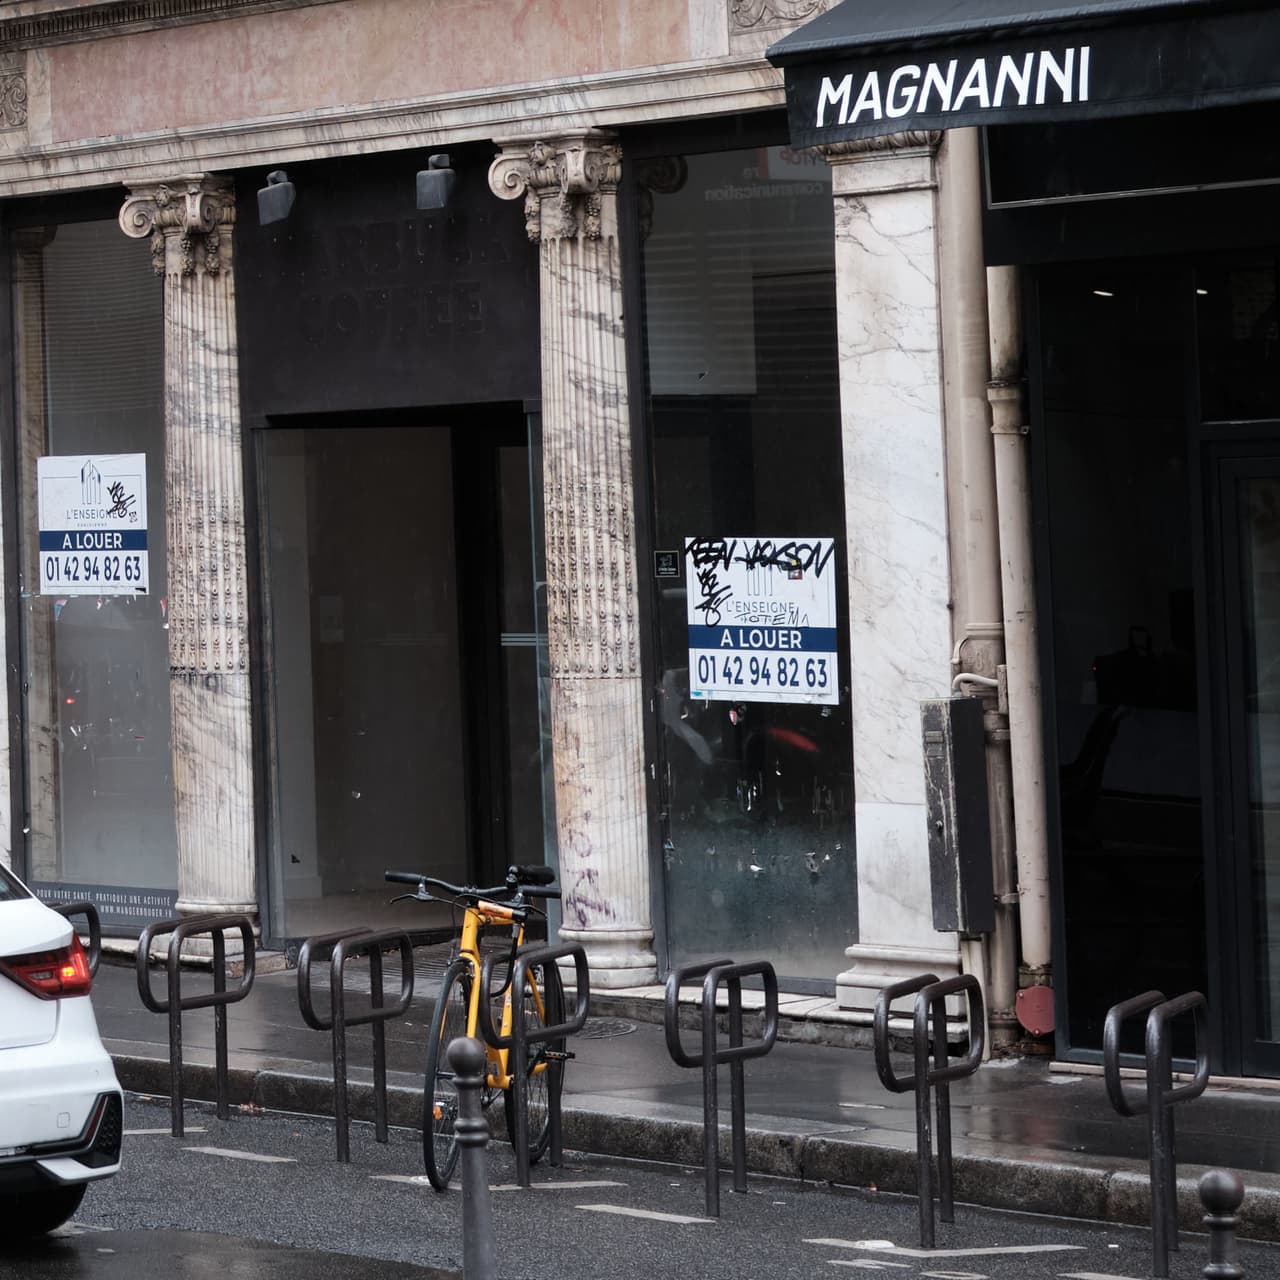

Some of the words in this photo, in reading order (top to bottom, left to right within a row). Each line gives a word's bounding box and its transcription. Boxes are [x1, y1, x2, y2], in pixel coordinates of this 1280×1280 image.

[816, 46, 1091, 128] MAGNANNI
[62, 533, 73, 550] A
[76, 532, 122, 549] LOUER
[46, 556, 60, 582] 01
[64, 556, 80, 581] 42
[83, 556, 100, 581] 94
[104, 556, 121, 581] 82
[124, 556, 141, 581] 63
[726, 602, 795, 613] L'ENSEIGNE
[720, 628, 734, 648] A
[739, 630, 802, 649] LOUER
[698, 655, 717, 684] 01
[723, 655, 744, 685] 42
[749, 656, 771, 686] 94
[777, 657, 800, 687] 82
[806, 658, 828, 688] 63
[54, 890, 71, 900] VOTRE
[130, 896, 141, 905] UNE
